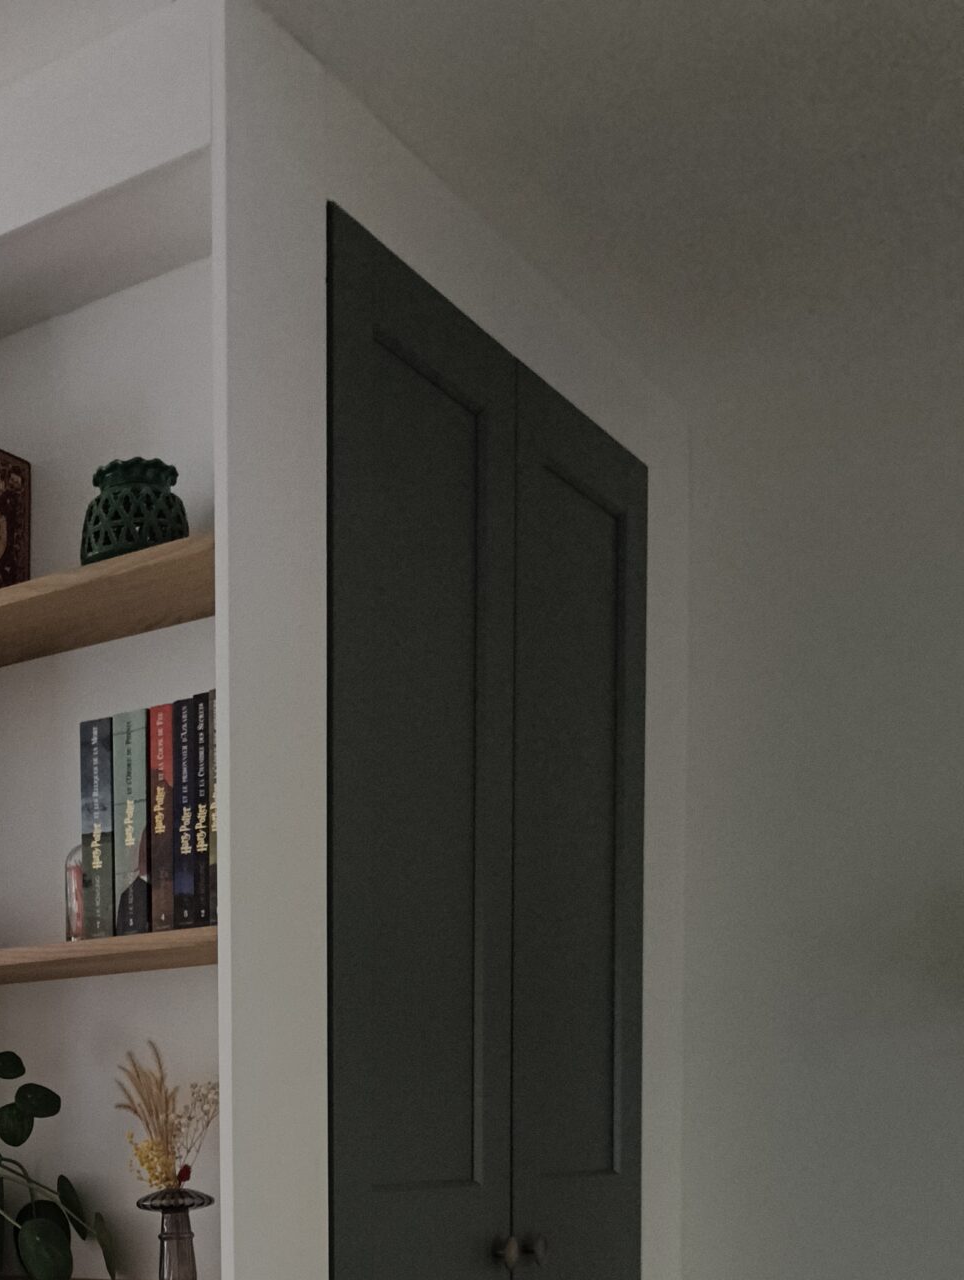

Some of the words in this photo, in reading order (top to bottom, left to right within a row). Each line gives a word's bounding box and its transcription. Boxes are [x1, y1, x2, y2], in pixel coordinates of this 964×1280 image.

[153, 786, 166, 812] Potter
[123, 799, 135, 824] Potter
[154, 812, 166, 834] Harry
[179, 806, 192, 832] Potter
[194, 803, 207, 830] Potter
[90, 823, 102, 848] Potter
[124, 825, 135, 848] Harry
[180, 832, 192, 855] Harry
[195, 830, 208, 853] Harry
[92, 848, 103, 869] Harry
